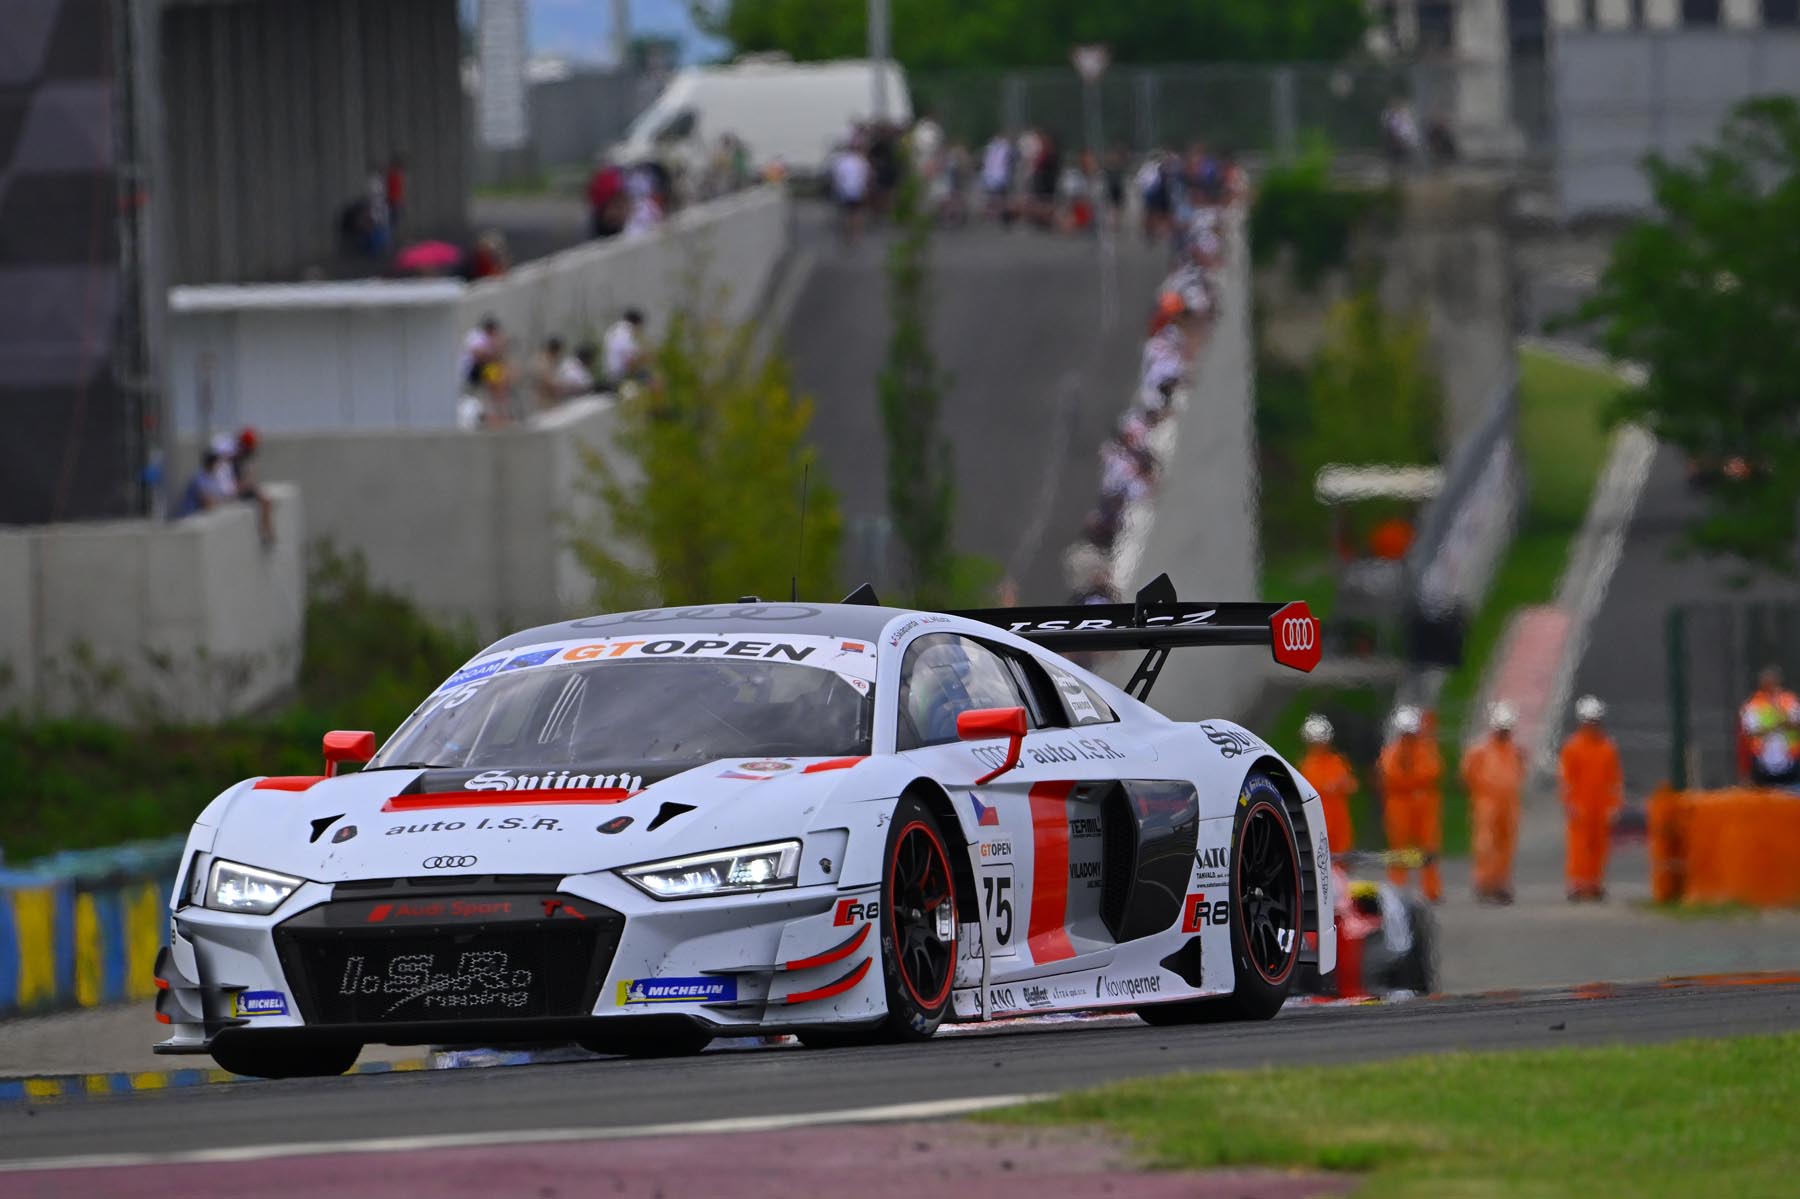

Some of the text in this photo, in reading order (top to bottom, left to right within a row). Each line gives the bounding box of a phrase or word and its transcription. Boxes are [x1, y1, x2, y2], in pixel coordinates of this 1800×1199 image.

[1027, 744, 1077, 764] auto
[385, 817, 564, 835] auto I.S.R.
[1195, 847, 1231, 872] SATO
[396, 899, 512, 917] Audi Sport
[982, 876, 1013, 945] 75
[648, 984, 724, 996] MICHELIN
[1105, 975, 1161, 997] kovoperner
